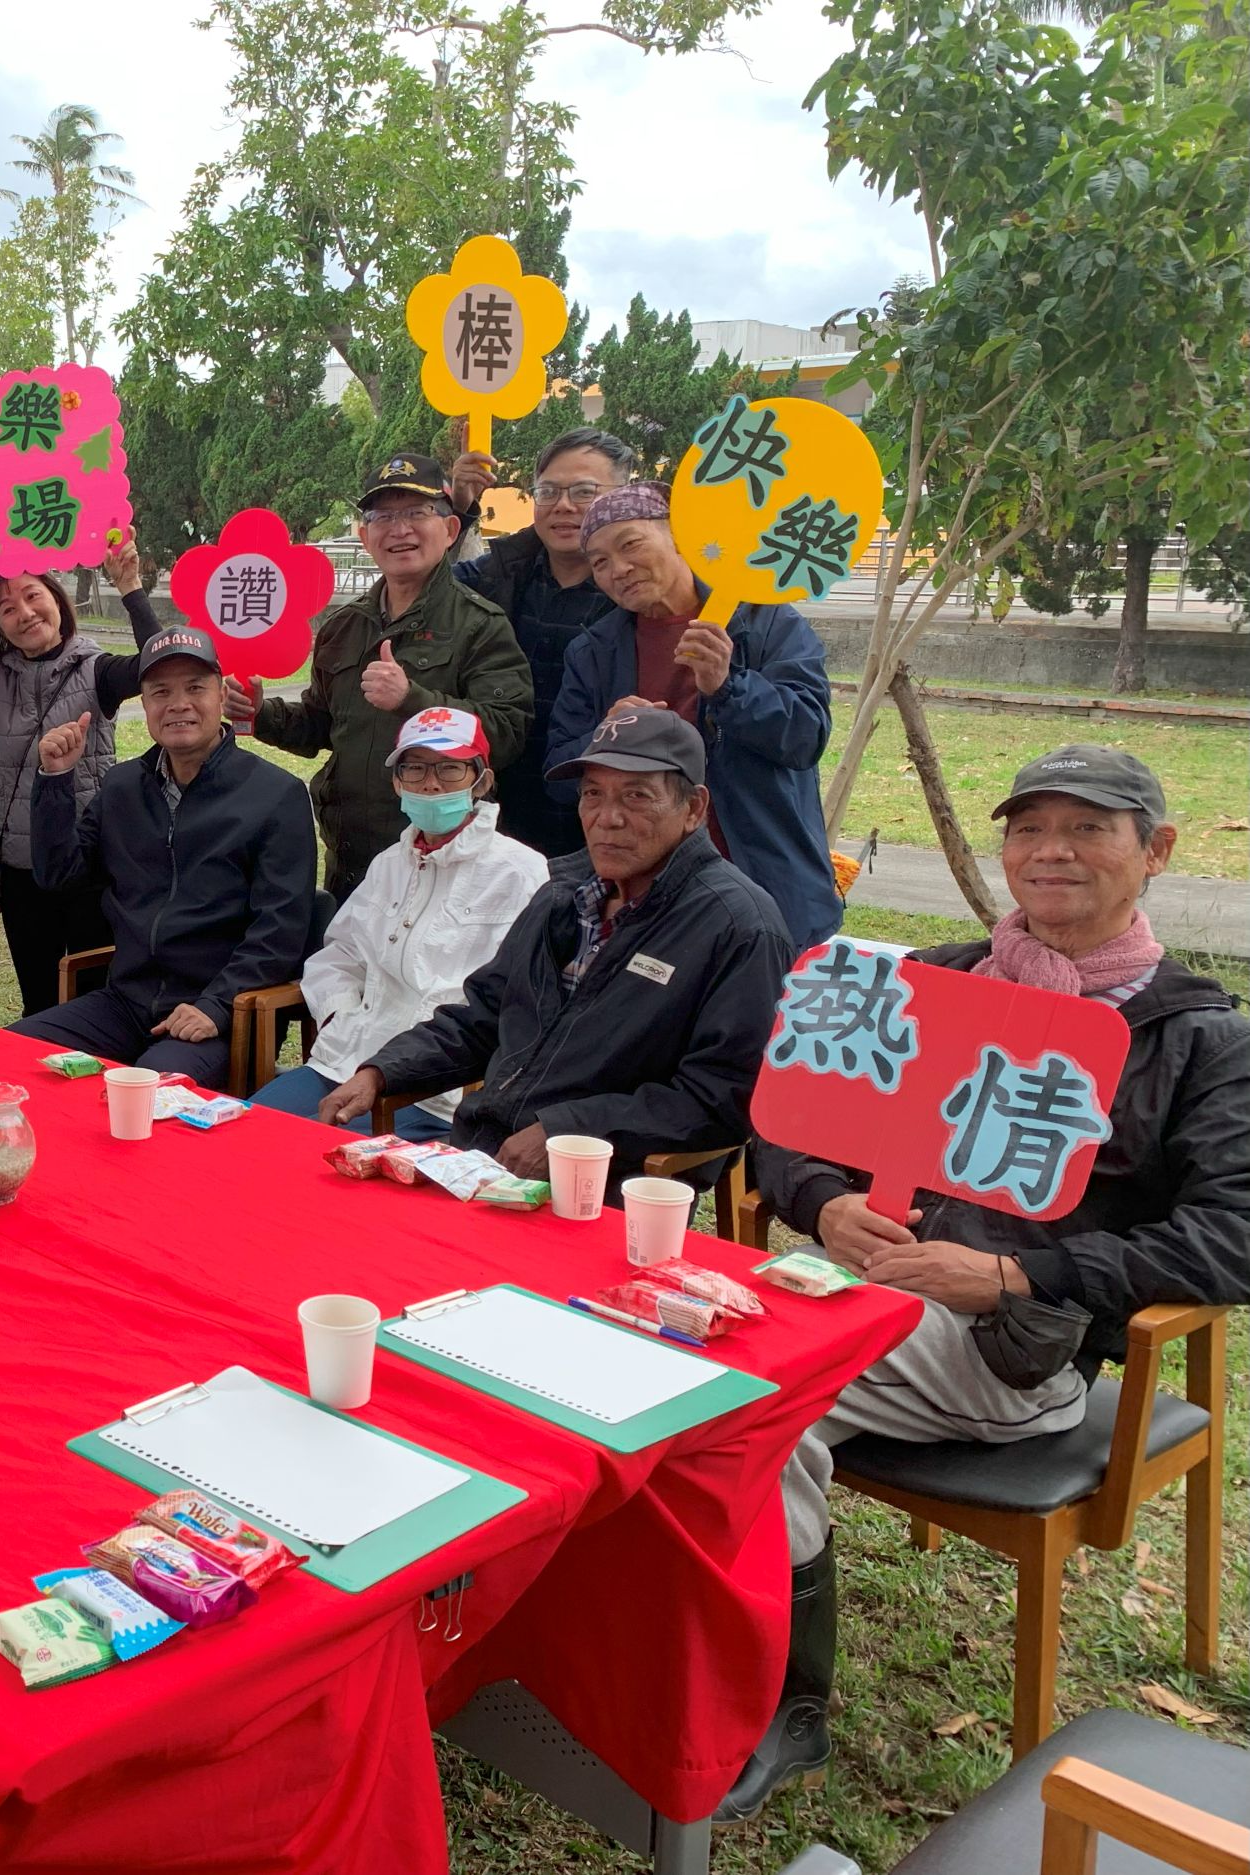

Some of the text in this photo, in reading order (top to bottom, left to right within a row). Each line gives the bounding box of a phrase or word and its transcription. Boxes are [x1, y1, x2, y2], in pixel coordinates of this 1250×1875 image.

[455, 290, 514, 382] 棒
[694, 408, 859, 598] 快樂
[219, 565, 277, 627] 讚
[150, 633, 202, 653] AIR ASIA
[774, 941, 1106, 1208] 熱情
[188, 1502, 233, 1536] Wafer
